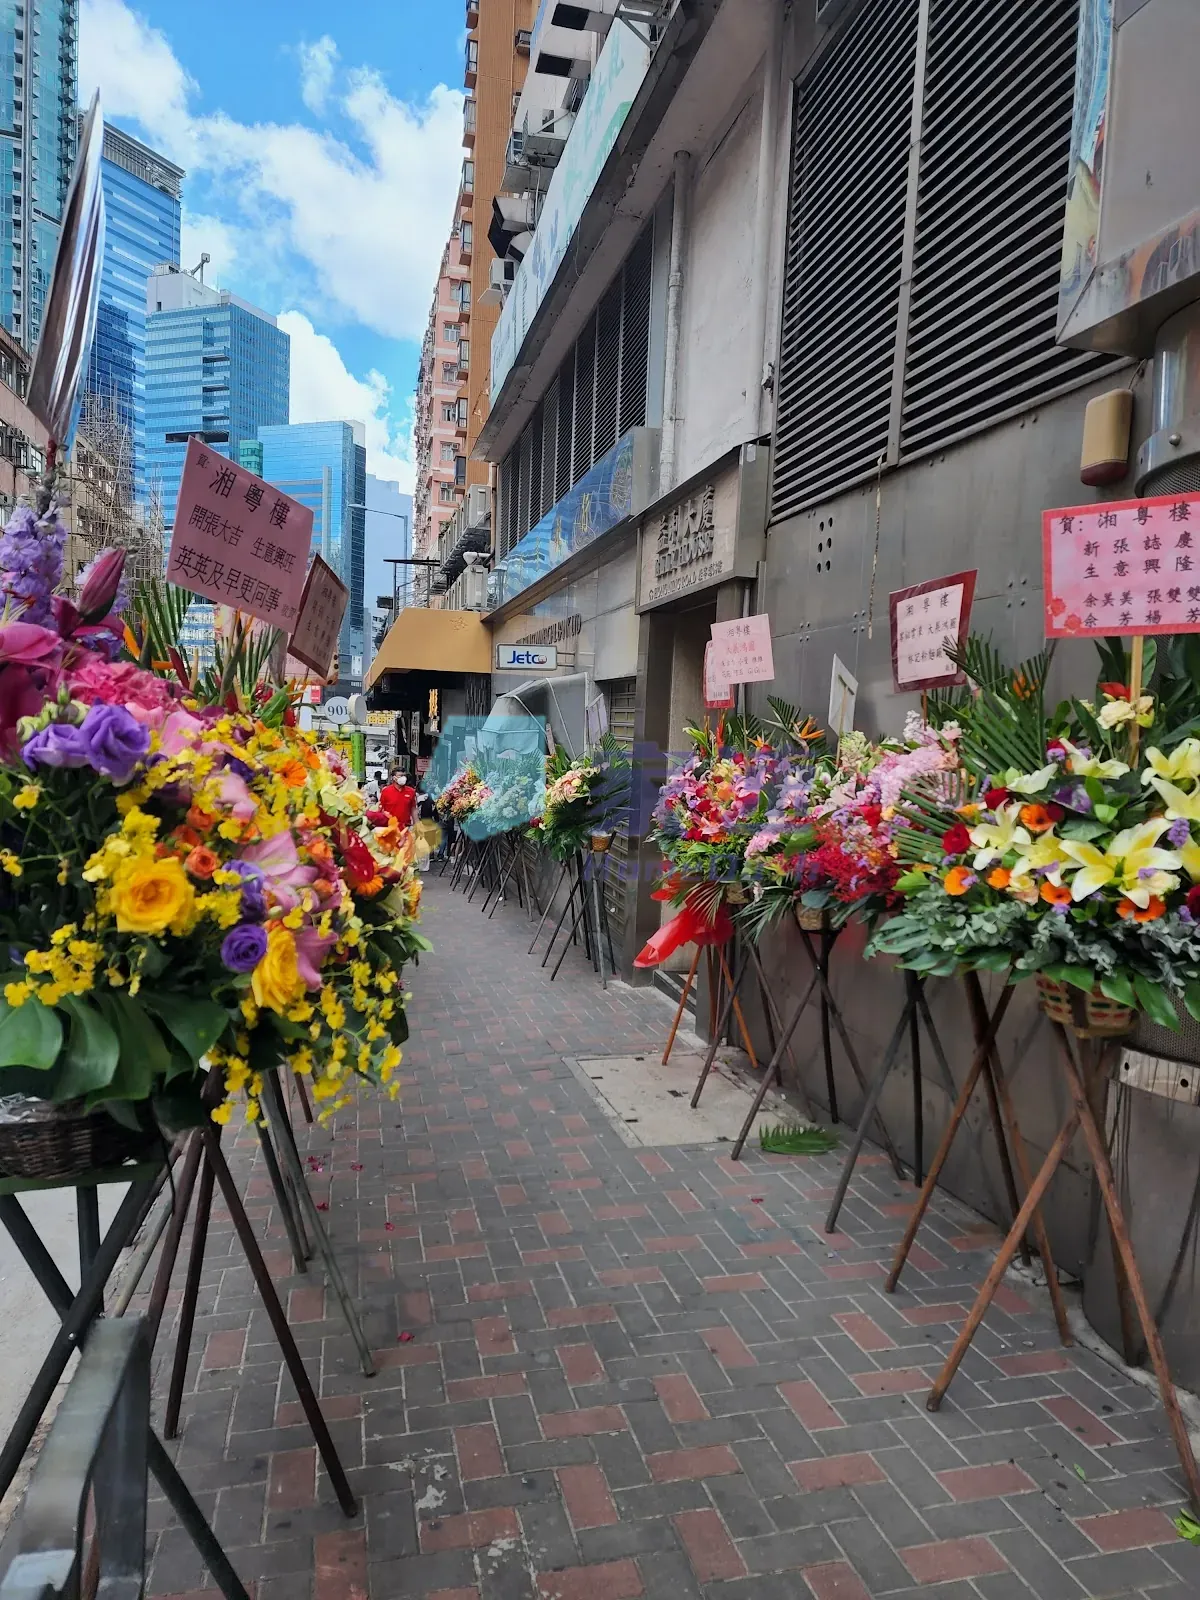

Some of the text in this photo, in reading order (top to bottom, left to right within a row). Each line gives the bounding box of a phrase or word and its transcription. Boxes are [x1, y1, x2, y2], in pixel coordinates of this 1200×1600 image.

[188, 504, 244, 547] 開張大吉
[208, 464, 291, 530] 湘粵樓
[171, 545, 283, 613] 英英及早更同事
